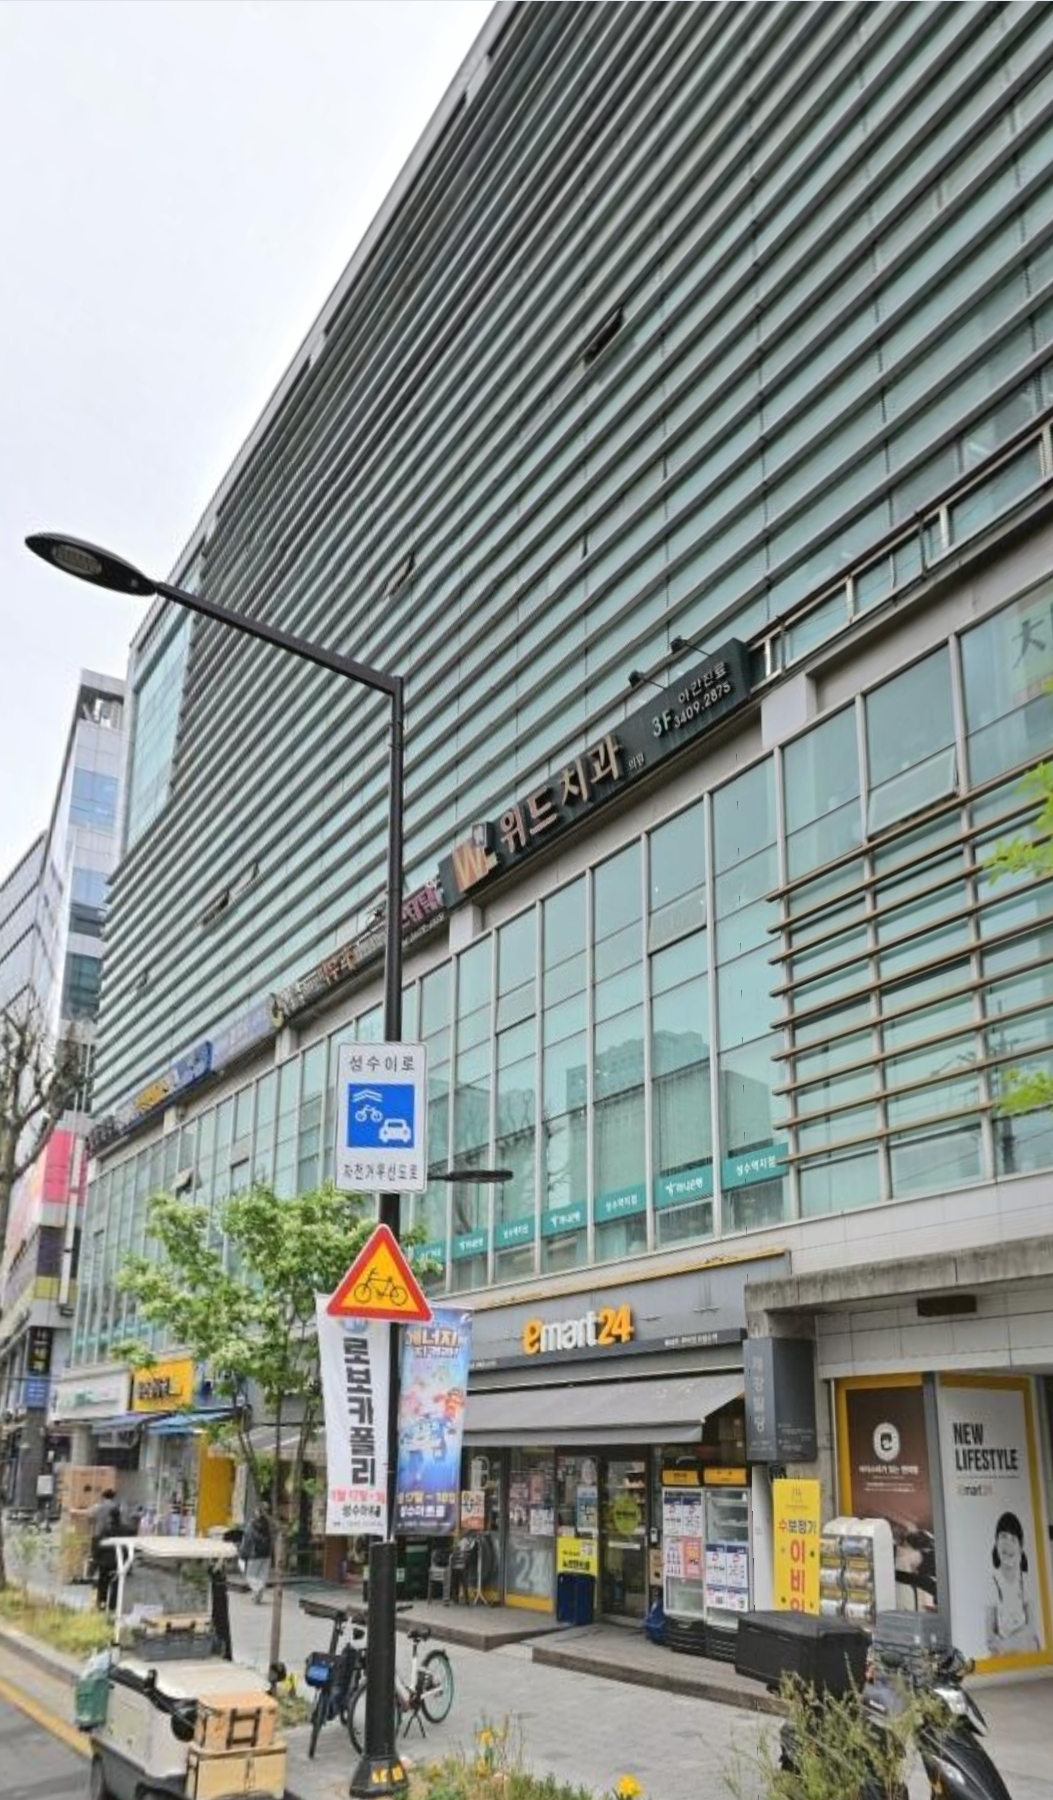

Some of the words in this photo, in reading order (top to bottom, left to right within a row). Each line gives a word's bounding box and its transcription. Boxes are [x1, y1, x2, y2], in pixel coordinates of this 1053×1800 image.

[652, 708, 672, 737] 3F
[500, 733, 623, 854] 위드치과
[349, 1055, 415, 1073] 성수이로
[343, 1163, 418, 1181] 자전거우선도로
[523, 1304, 635, 1354] emart24
[343, 1336, 377, 1487] 로보카폴리
[953, 1423, 983, 1446] NEW
[955, 1448, 1019, 1471] LIFESTYLE
